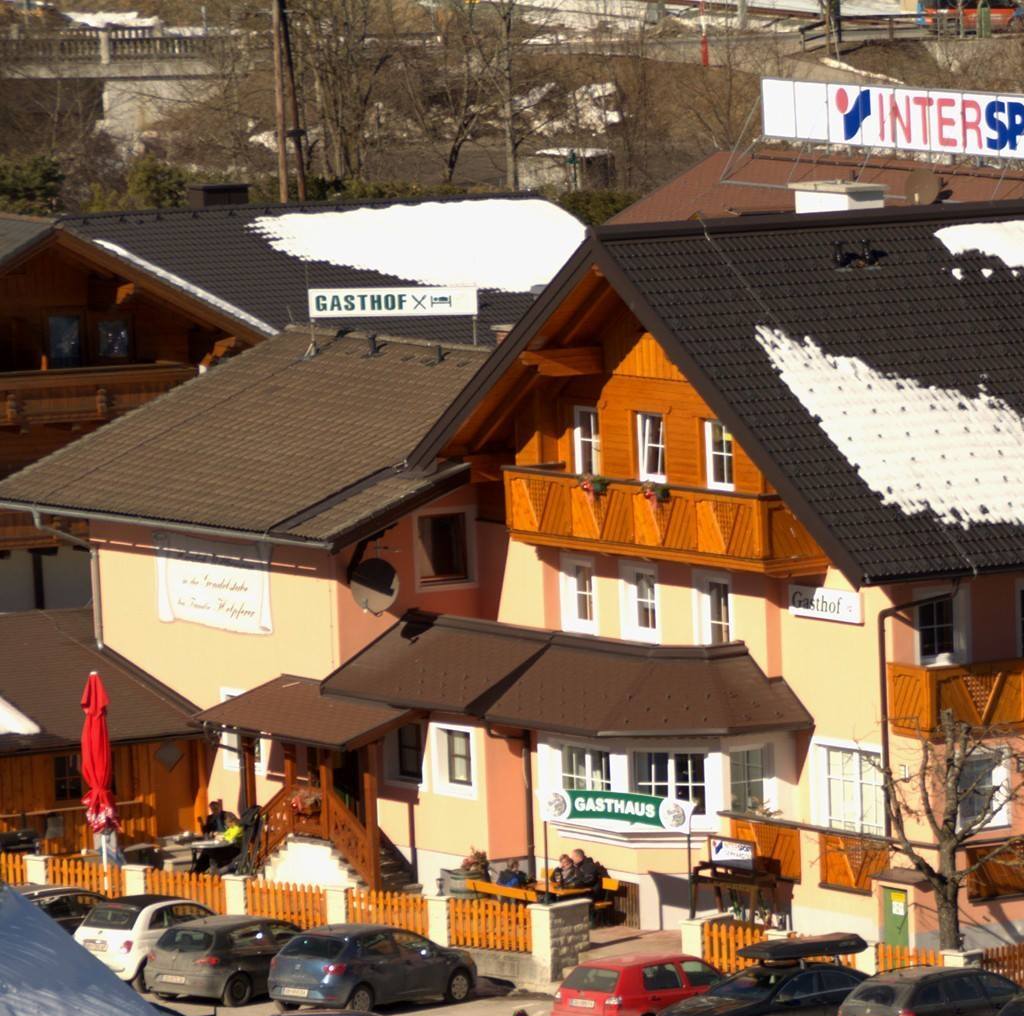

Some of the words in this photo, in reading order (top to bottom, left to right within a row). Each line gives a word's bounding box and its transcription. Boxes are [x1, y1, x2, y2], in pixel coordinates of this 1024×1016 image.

[315, 293, 407, 311] GASTHOF
[792, 591, 843, 614] Gasthof
[574, 796, 656, 818] GASTHAUS
